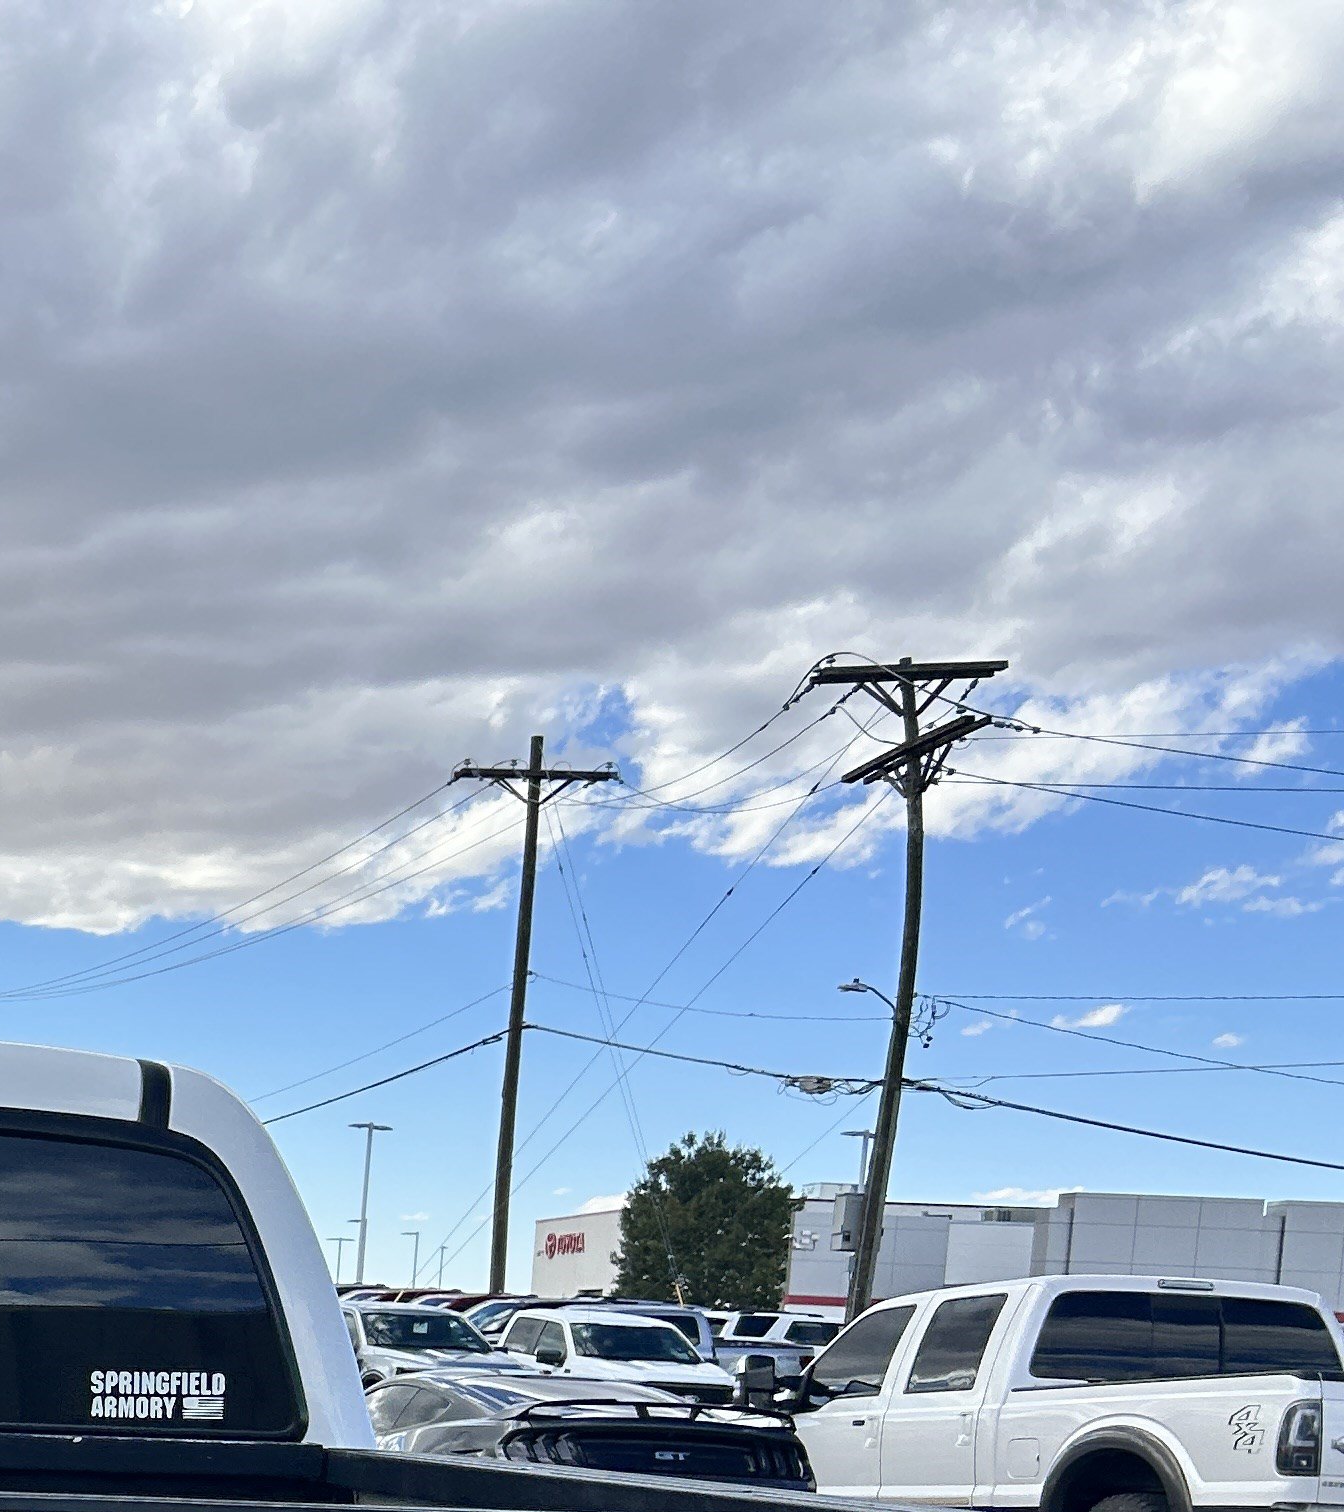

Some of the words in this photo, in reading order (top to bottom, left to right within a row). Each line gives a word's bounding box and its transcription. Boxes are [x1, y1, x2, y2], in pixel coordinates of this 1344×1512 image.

[90, 1370, 226, 1396] SPRINGFIELD
[90, 1396, 176, 1419] ARMORY
[655, 1451, 690, 1461] GT
